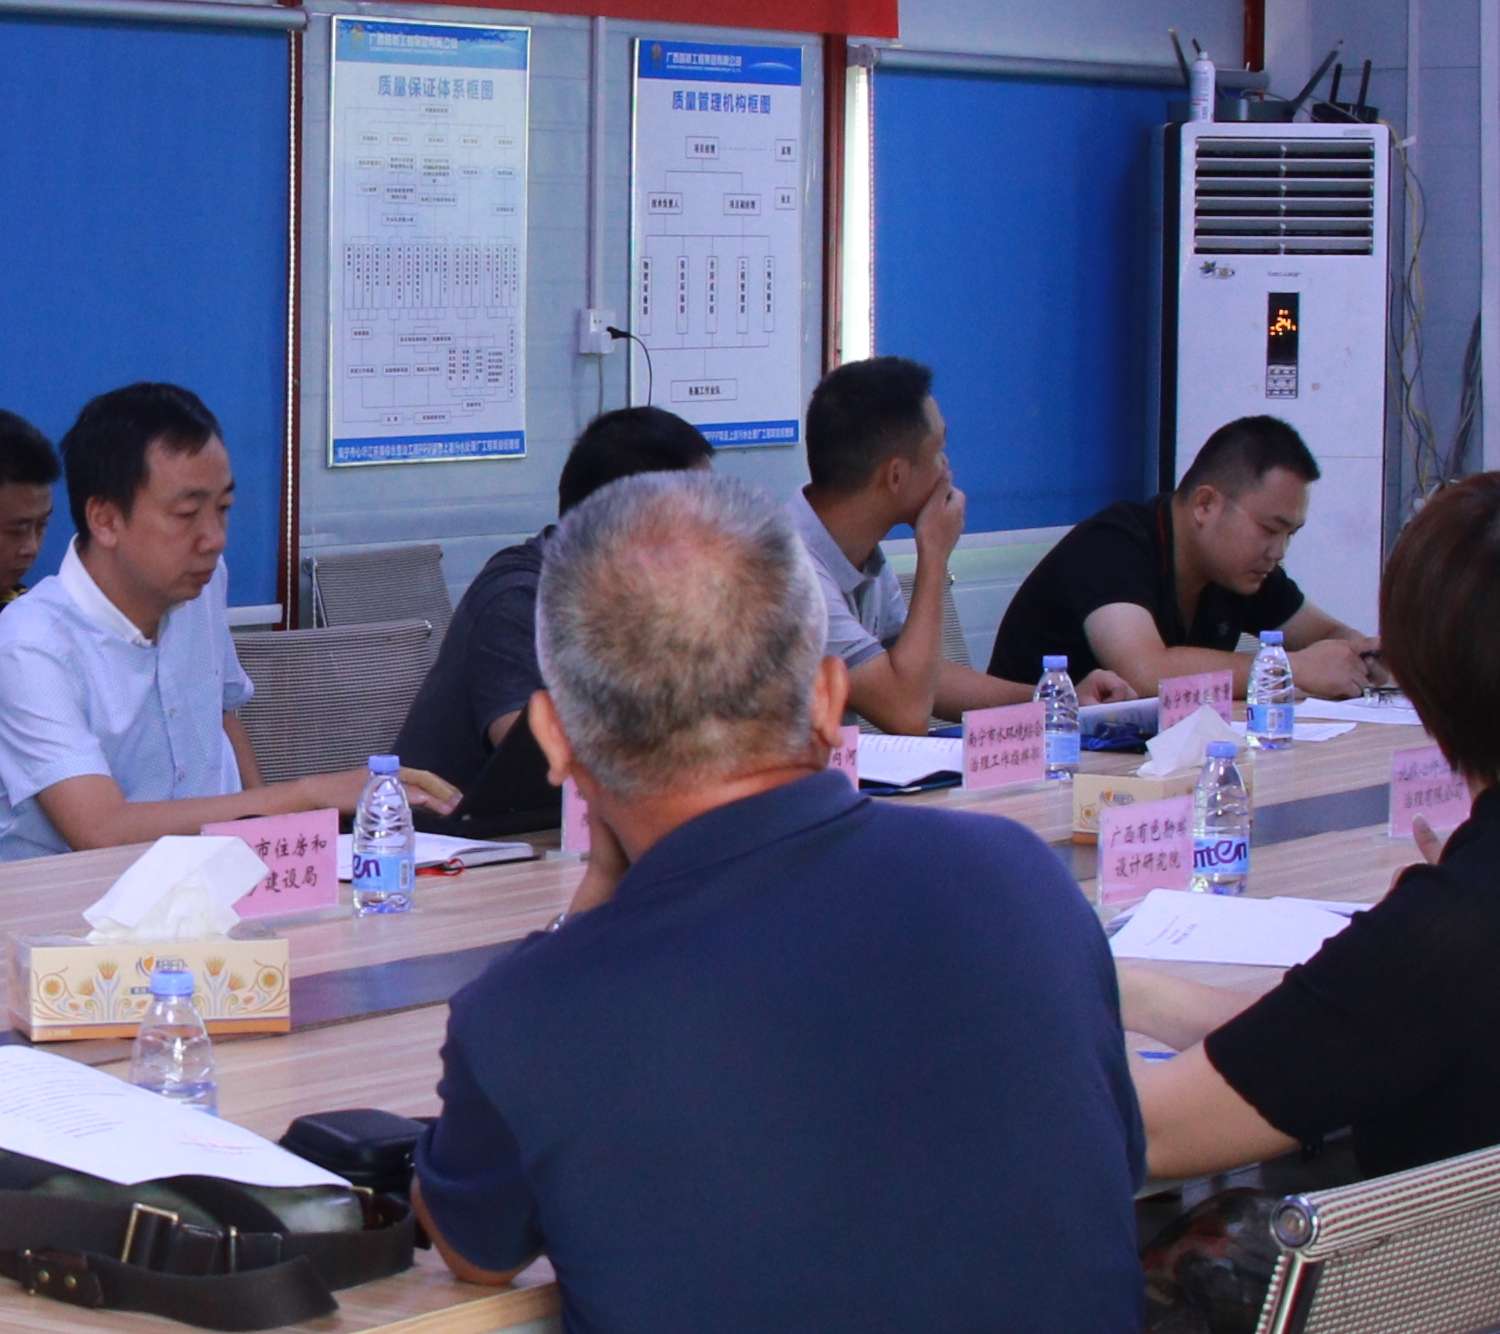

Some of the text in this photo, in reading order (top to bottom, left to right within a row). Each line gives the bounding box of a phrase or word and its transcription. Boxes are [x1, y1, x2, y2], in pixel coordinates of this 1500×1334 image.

[378, 74, 493, 101] 质量保证体系框图
[671, 90, 771, 115] 质量管理机构框图
[1114, 851, 1181, 878] 设计研究院
